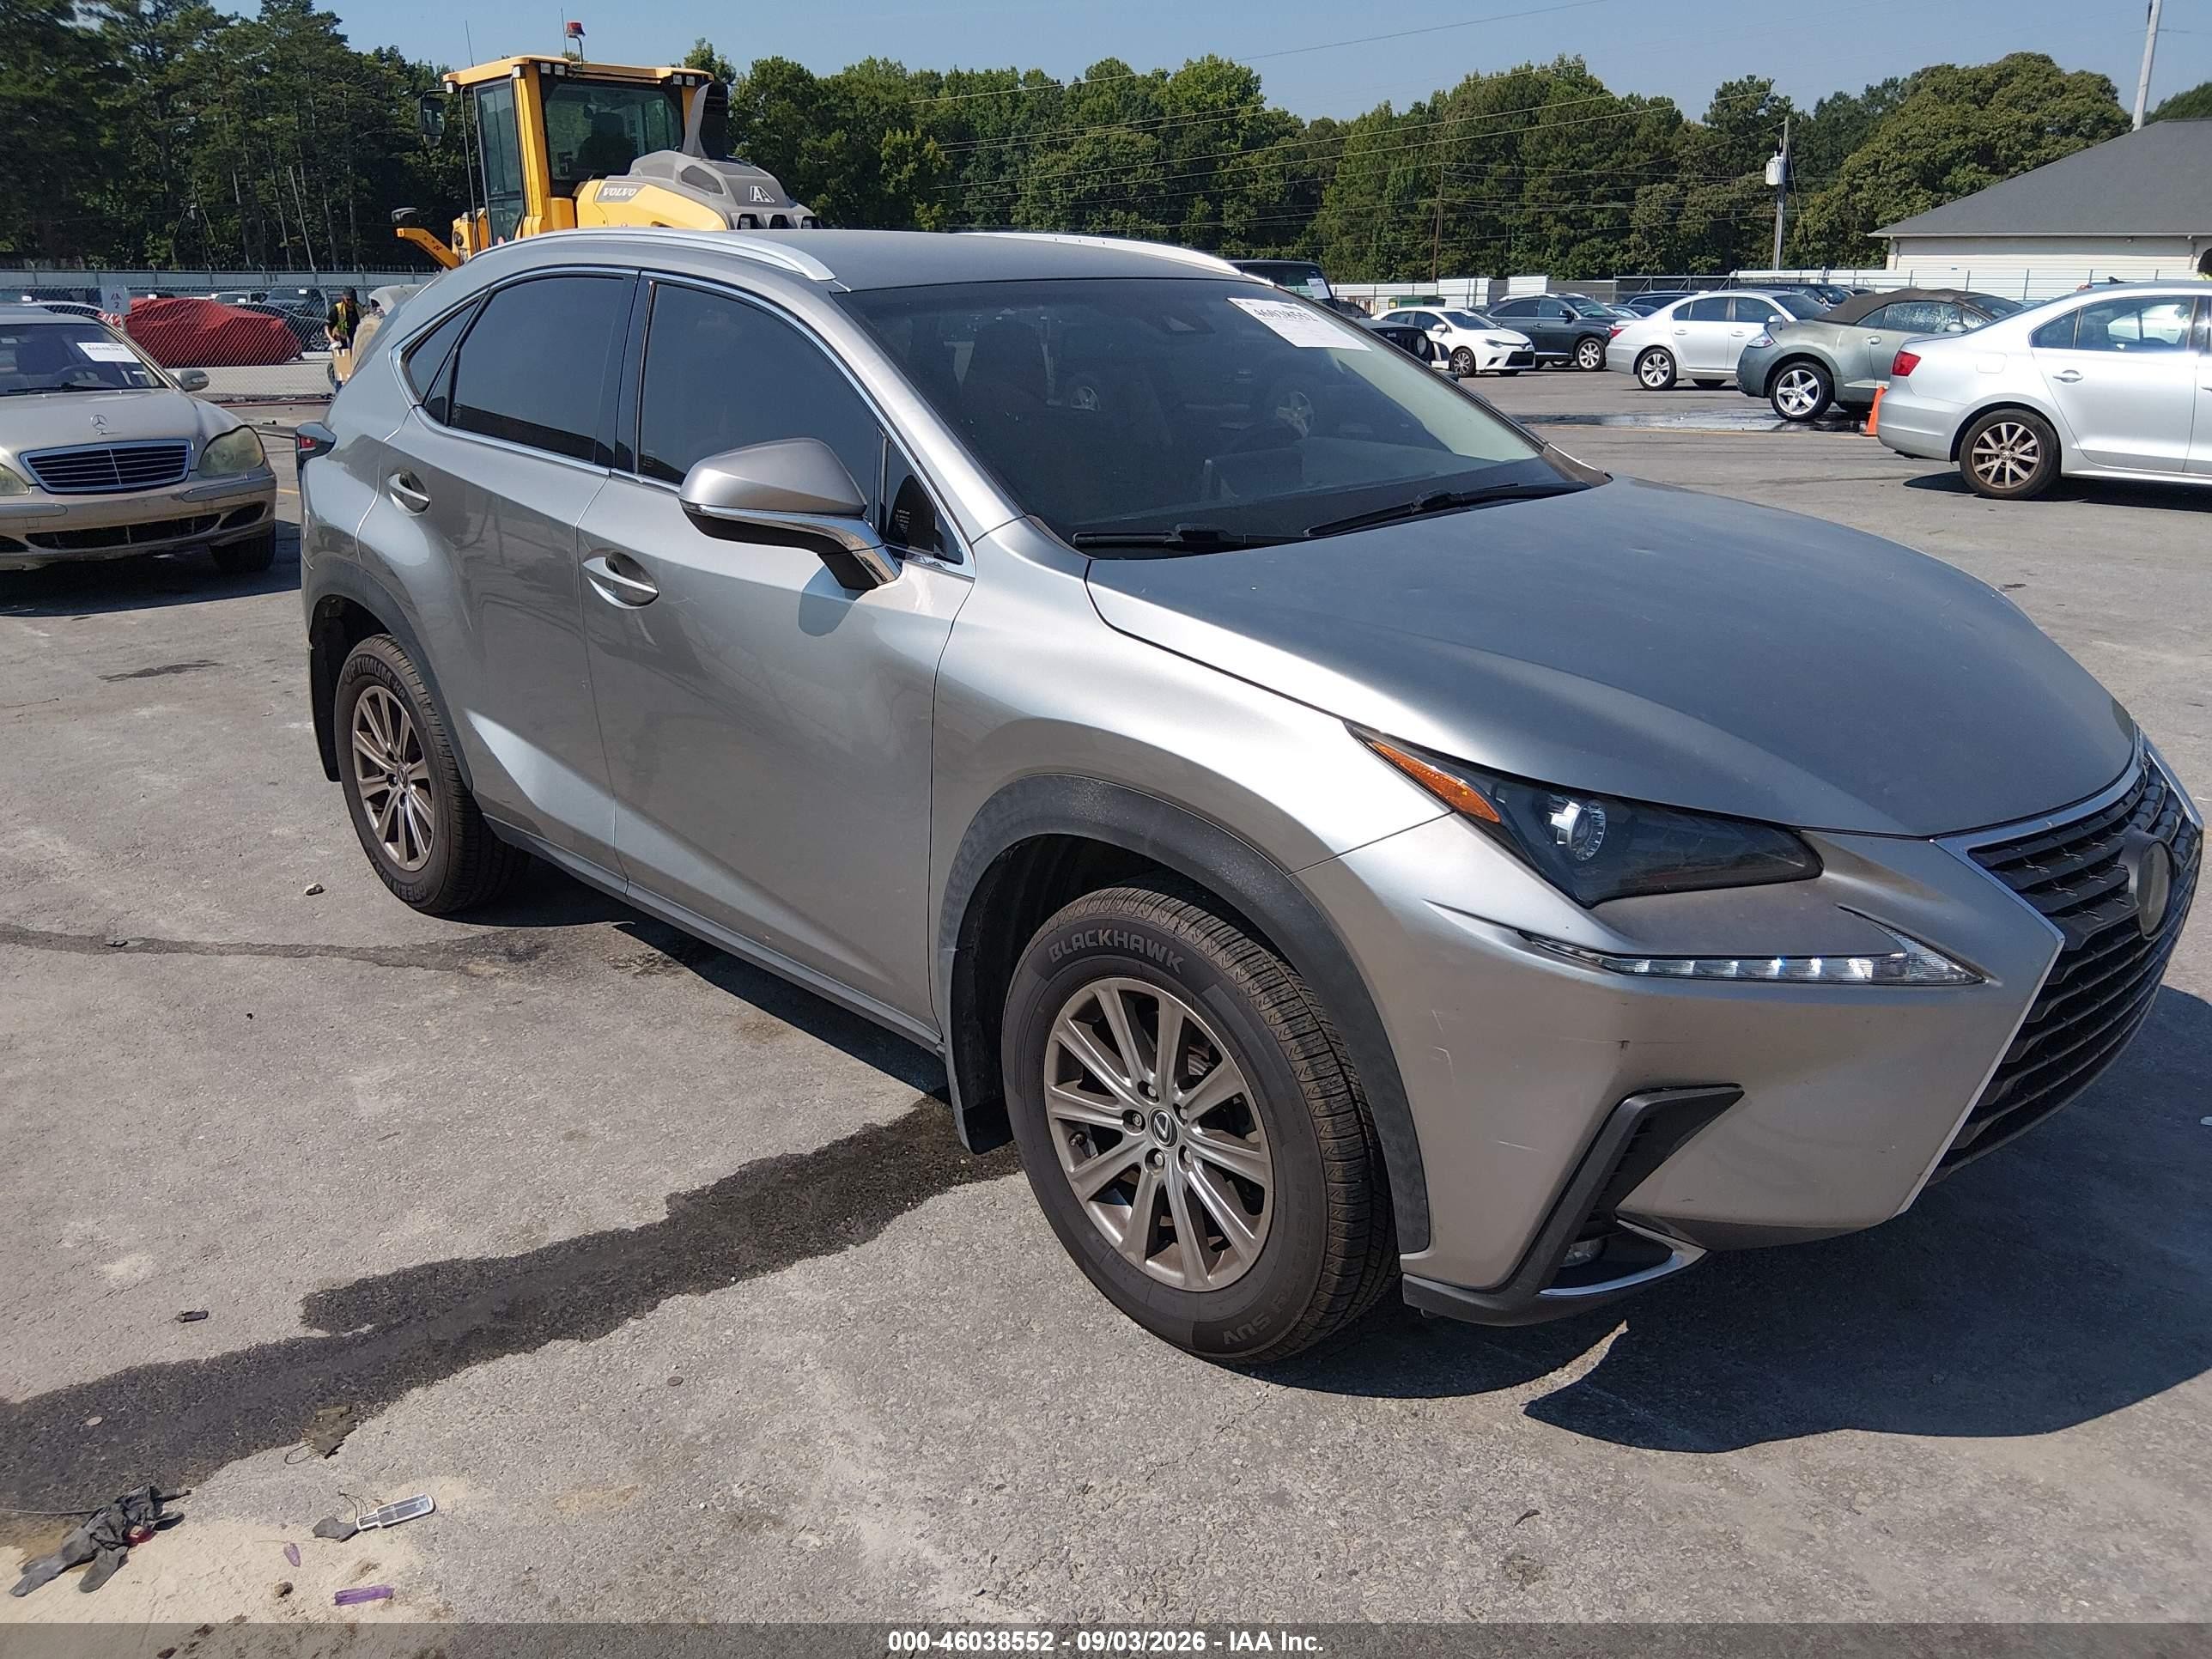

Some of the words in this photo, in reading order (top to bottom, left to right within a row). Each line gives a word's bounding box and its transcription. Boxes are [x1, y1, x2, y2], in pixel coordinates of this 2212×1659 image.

[602, 186, 638, 198] VOLVO
[343, 657, 392, 684] OPTIMUM
[1048, 929, 1184, 975] BLACKHAWK
[1223, 1312, 1271, 1346] SUV
